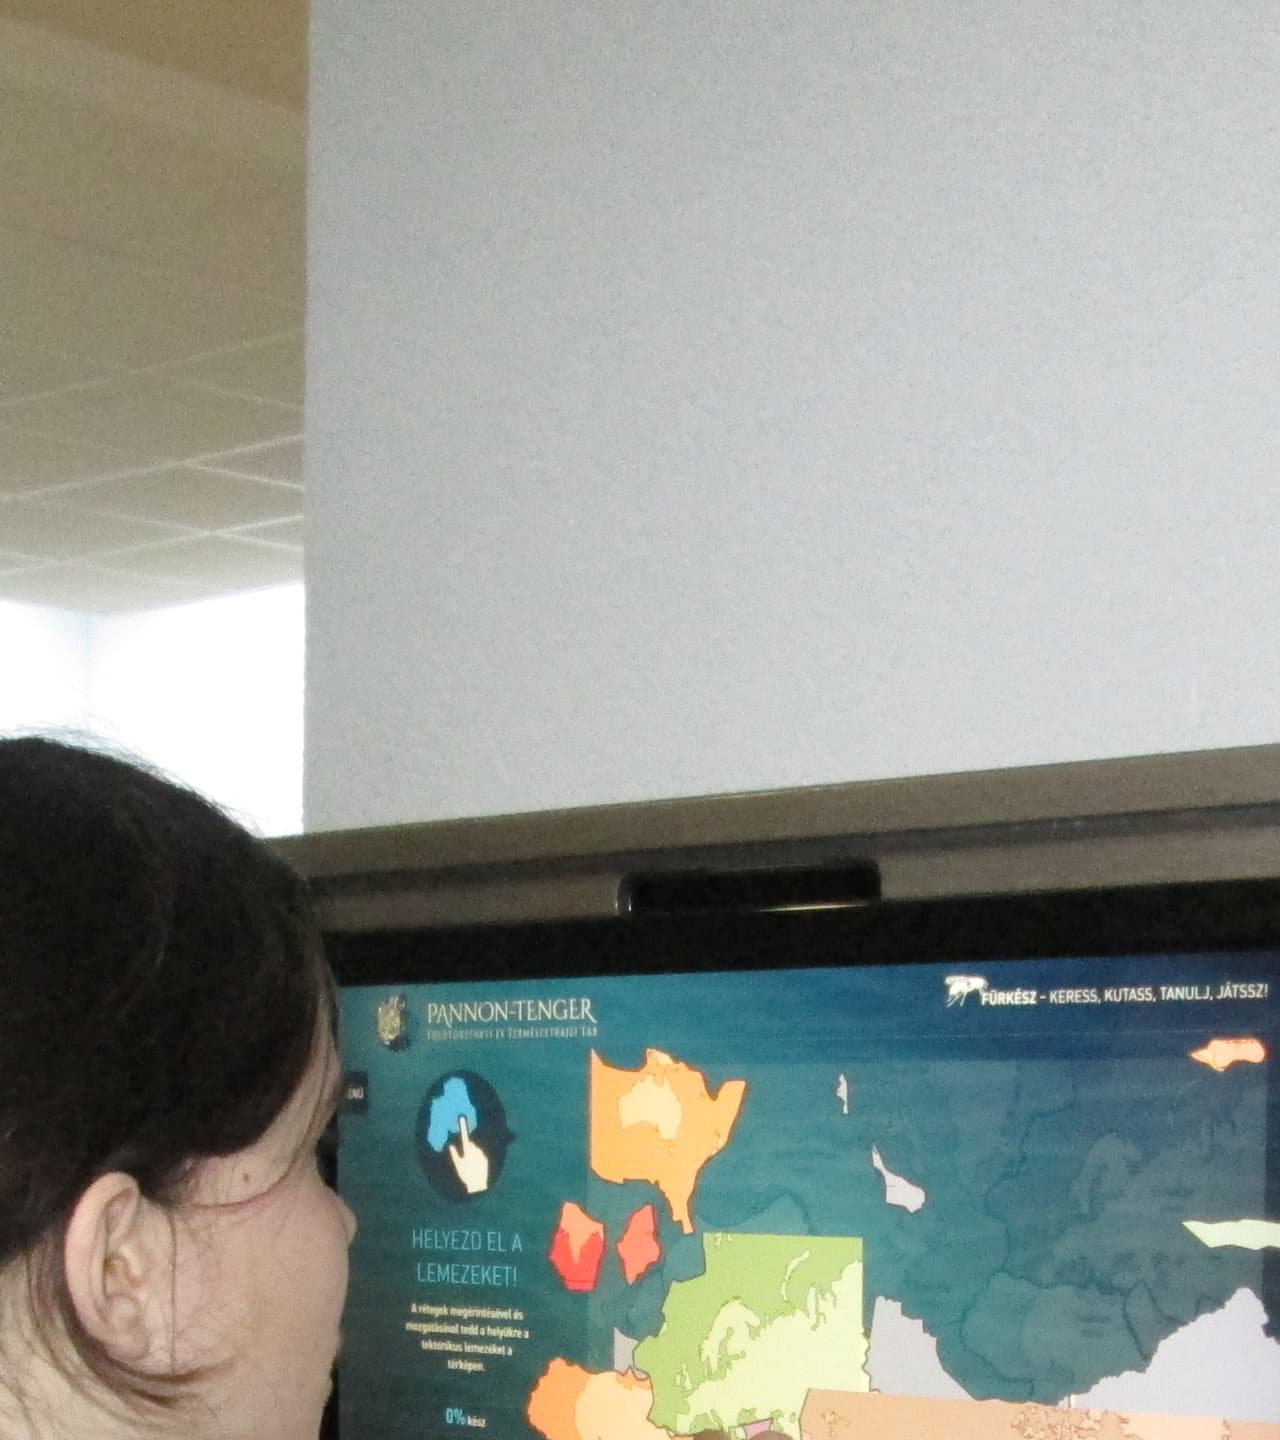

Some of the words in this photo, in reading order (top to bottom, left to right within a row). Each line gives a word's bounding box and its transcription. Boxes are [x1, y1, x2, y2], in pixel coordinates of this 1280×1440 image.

[1050, 990, 1101, 1004] KERESS,
[1104, 987, 1156, 1003] KUTASS,
[1159, 985, 1213, 1001] TANULJ,
[1216, 983, 1269, 999] JÁTSSZ!
[427, 997, 597, 1028] PANNON-TENGER
[412, 1229, 482, 1251] HELYEZD
[487, 1232, 506, 1252] EL
[512, 1233, 522, 1252] A
[417, 1263, 517, 1287] LEMEZEKET!
[411, 1304, 417, 1312] A
[480, 1327, 485, 1335] a
[523, 1330, 529, 1339] a
[507, 1347, 513, 1356] a
[446, 1408, 465, 1425] 0%
